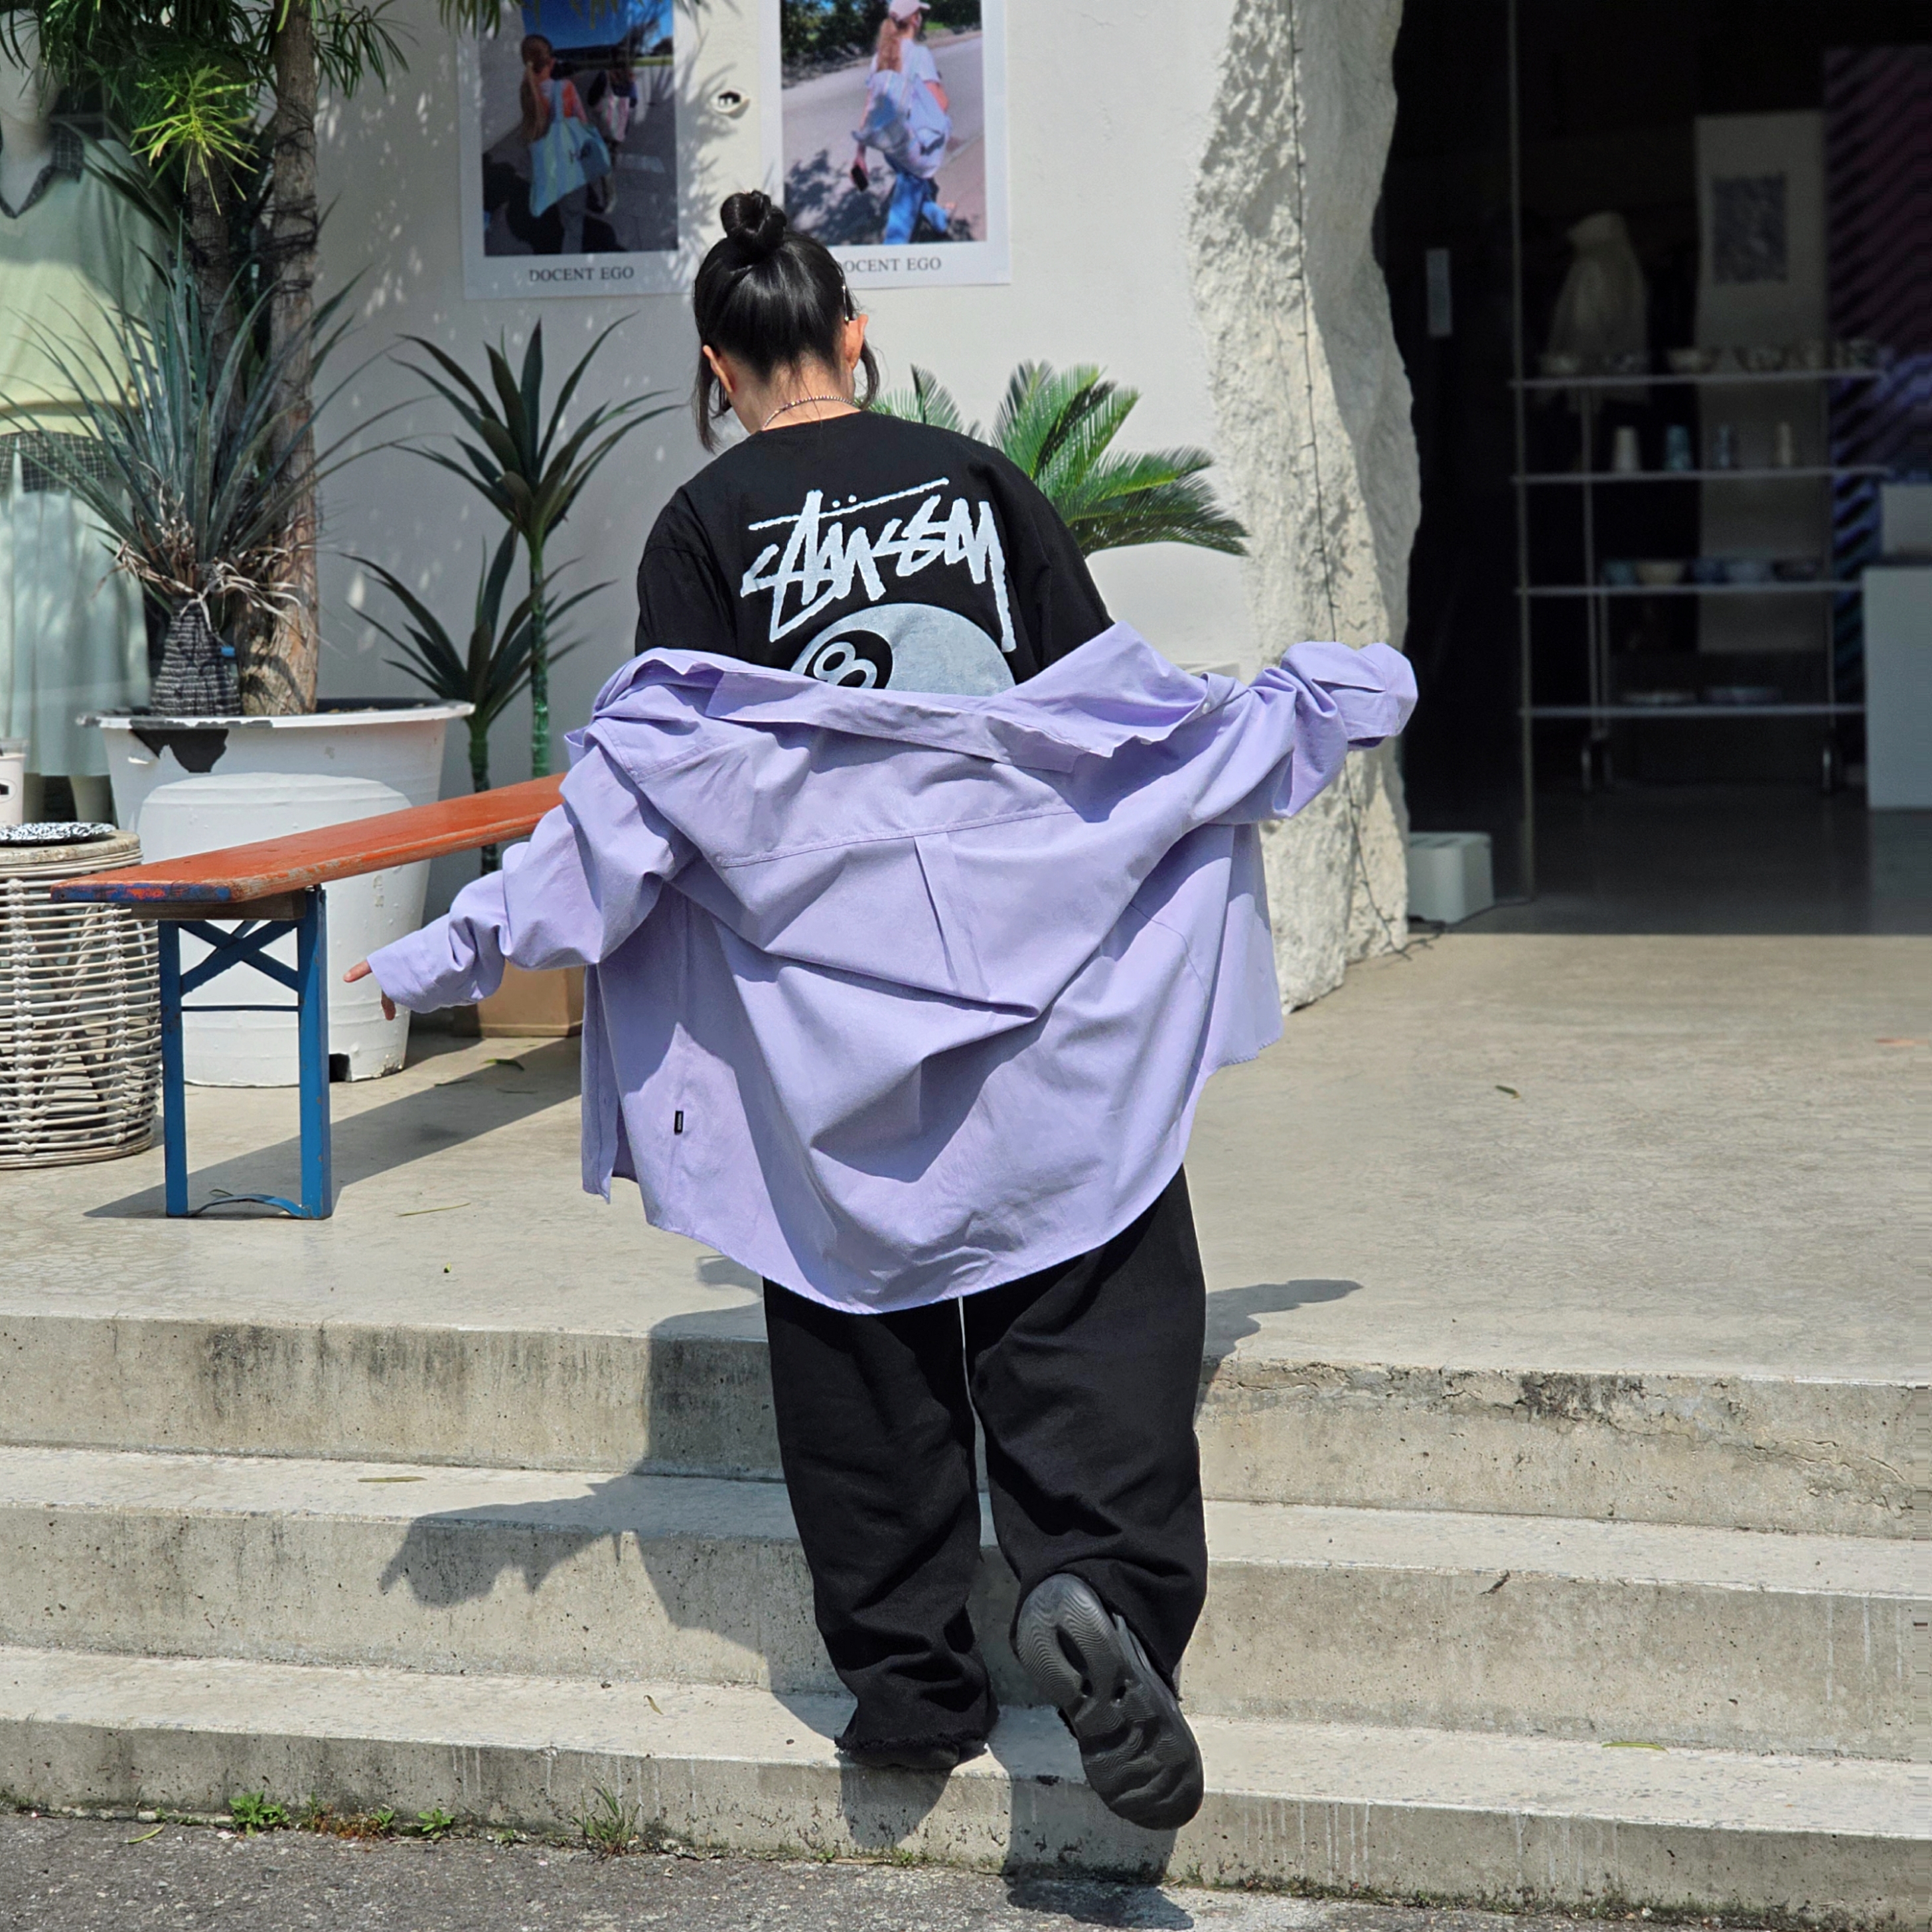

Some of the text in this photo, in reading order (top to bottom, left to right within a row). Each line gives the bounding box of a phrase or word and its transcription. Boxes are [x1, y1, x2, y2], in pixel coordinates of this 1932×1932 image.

[842, 257, 942, 273] OCENT EGO
[529, 266, 634, 281] DOCENT EGO
